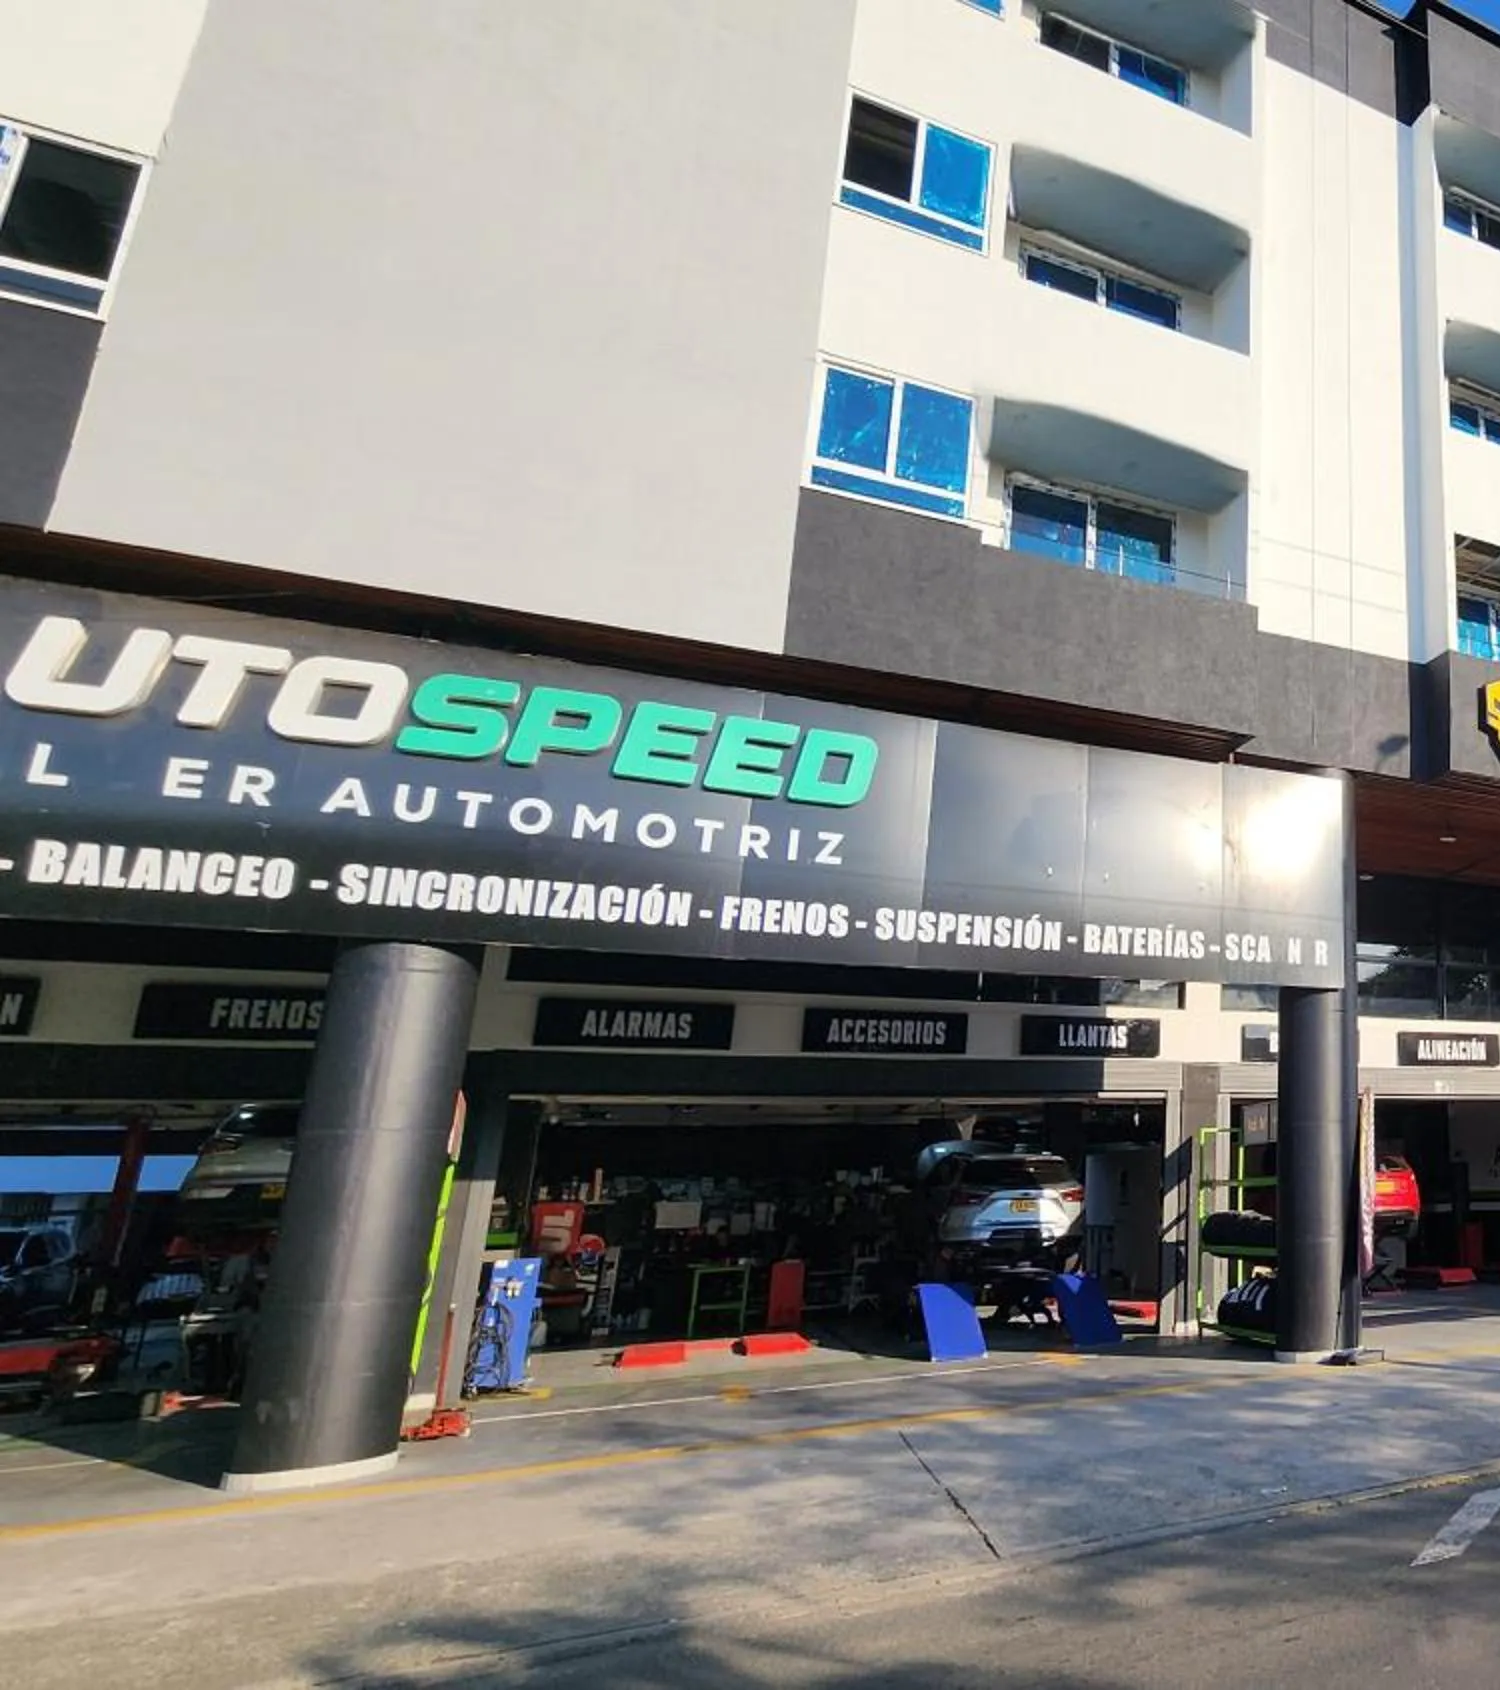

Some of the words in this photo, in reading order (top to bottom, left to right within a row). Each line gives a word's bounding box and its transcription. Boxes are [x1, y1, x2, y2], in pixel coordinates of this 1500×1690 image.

[320, 778, 845, 866] AUTOMOTRIZ
[27, 839, 296, 899] BALANCEO
[337, 863, 692, 927] SINCRONIZACIÓN
[720, 896, 849, 938] FRENOS
[875, 908, 1062, 951] SUSPENSIÓN
[1083, 924, 1205, 960] BATERÍAS
[210, 998, 323, 1029] FRENOS
[581, 1009, 692, 1039] ALARMAS
[826, 1017, 947, 1046] ACCESORIOS
[1059, 1023, 1128, 1049] LLANTAS
[1417, 1037, 1487, 1061] ALINEACIÓN
